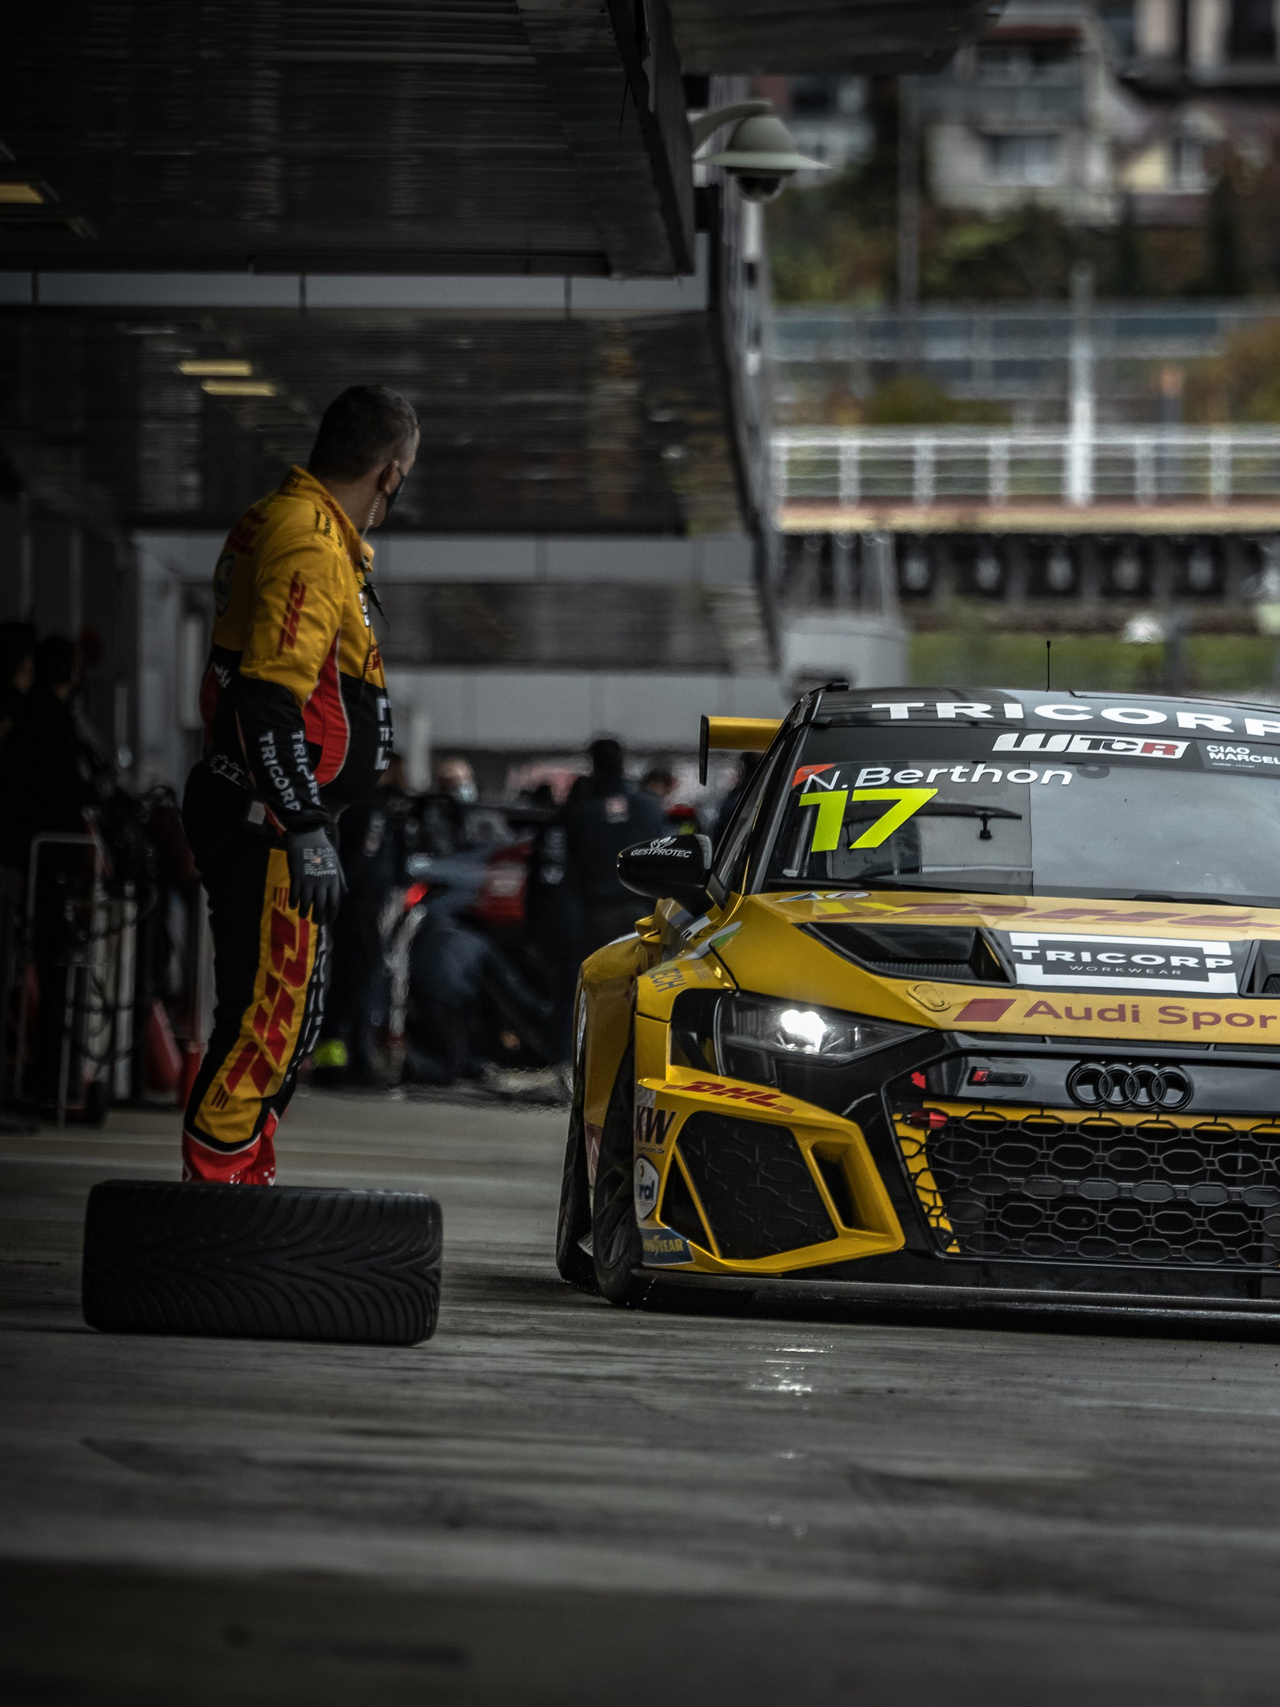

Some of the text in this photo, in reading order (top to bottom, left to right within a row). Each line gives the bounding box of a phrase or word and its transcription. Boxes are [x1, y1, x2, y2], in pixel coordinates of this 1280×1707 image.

[277, 572, 307, 656] DHL
[992, 733, 1190, 759] WTCR
[1206, 745, 1250, 755] CIAO
[802, 766, 1074, 794] N.Berthon
[798, 788, 939, 853] 17
[630, 848, 694, 859] GESTPROTEC
[1012, 948, 1235, 969] TRICORP
[1068, 965, 1182, 976] WORKWEAR
[225, 905, 311, 1097] DHL
[1022, 1000, 1140, 1023] Audi
[678, 1080, 782, 1108] DHL
[636, 1105, 677, 1145] KW
